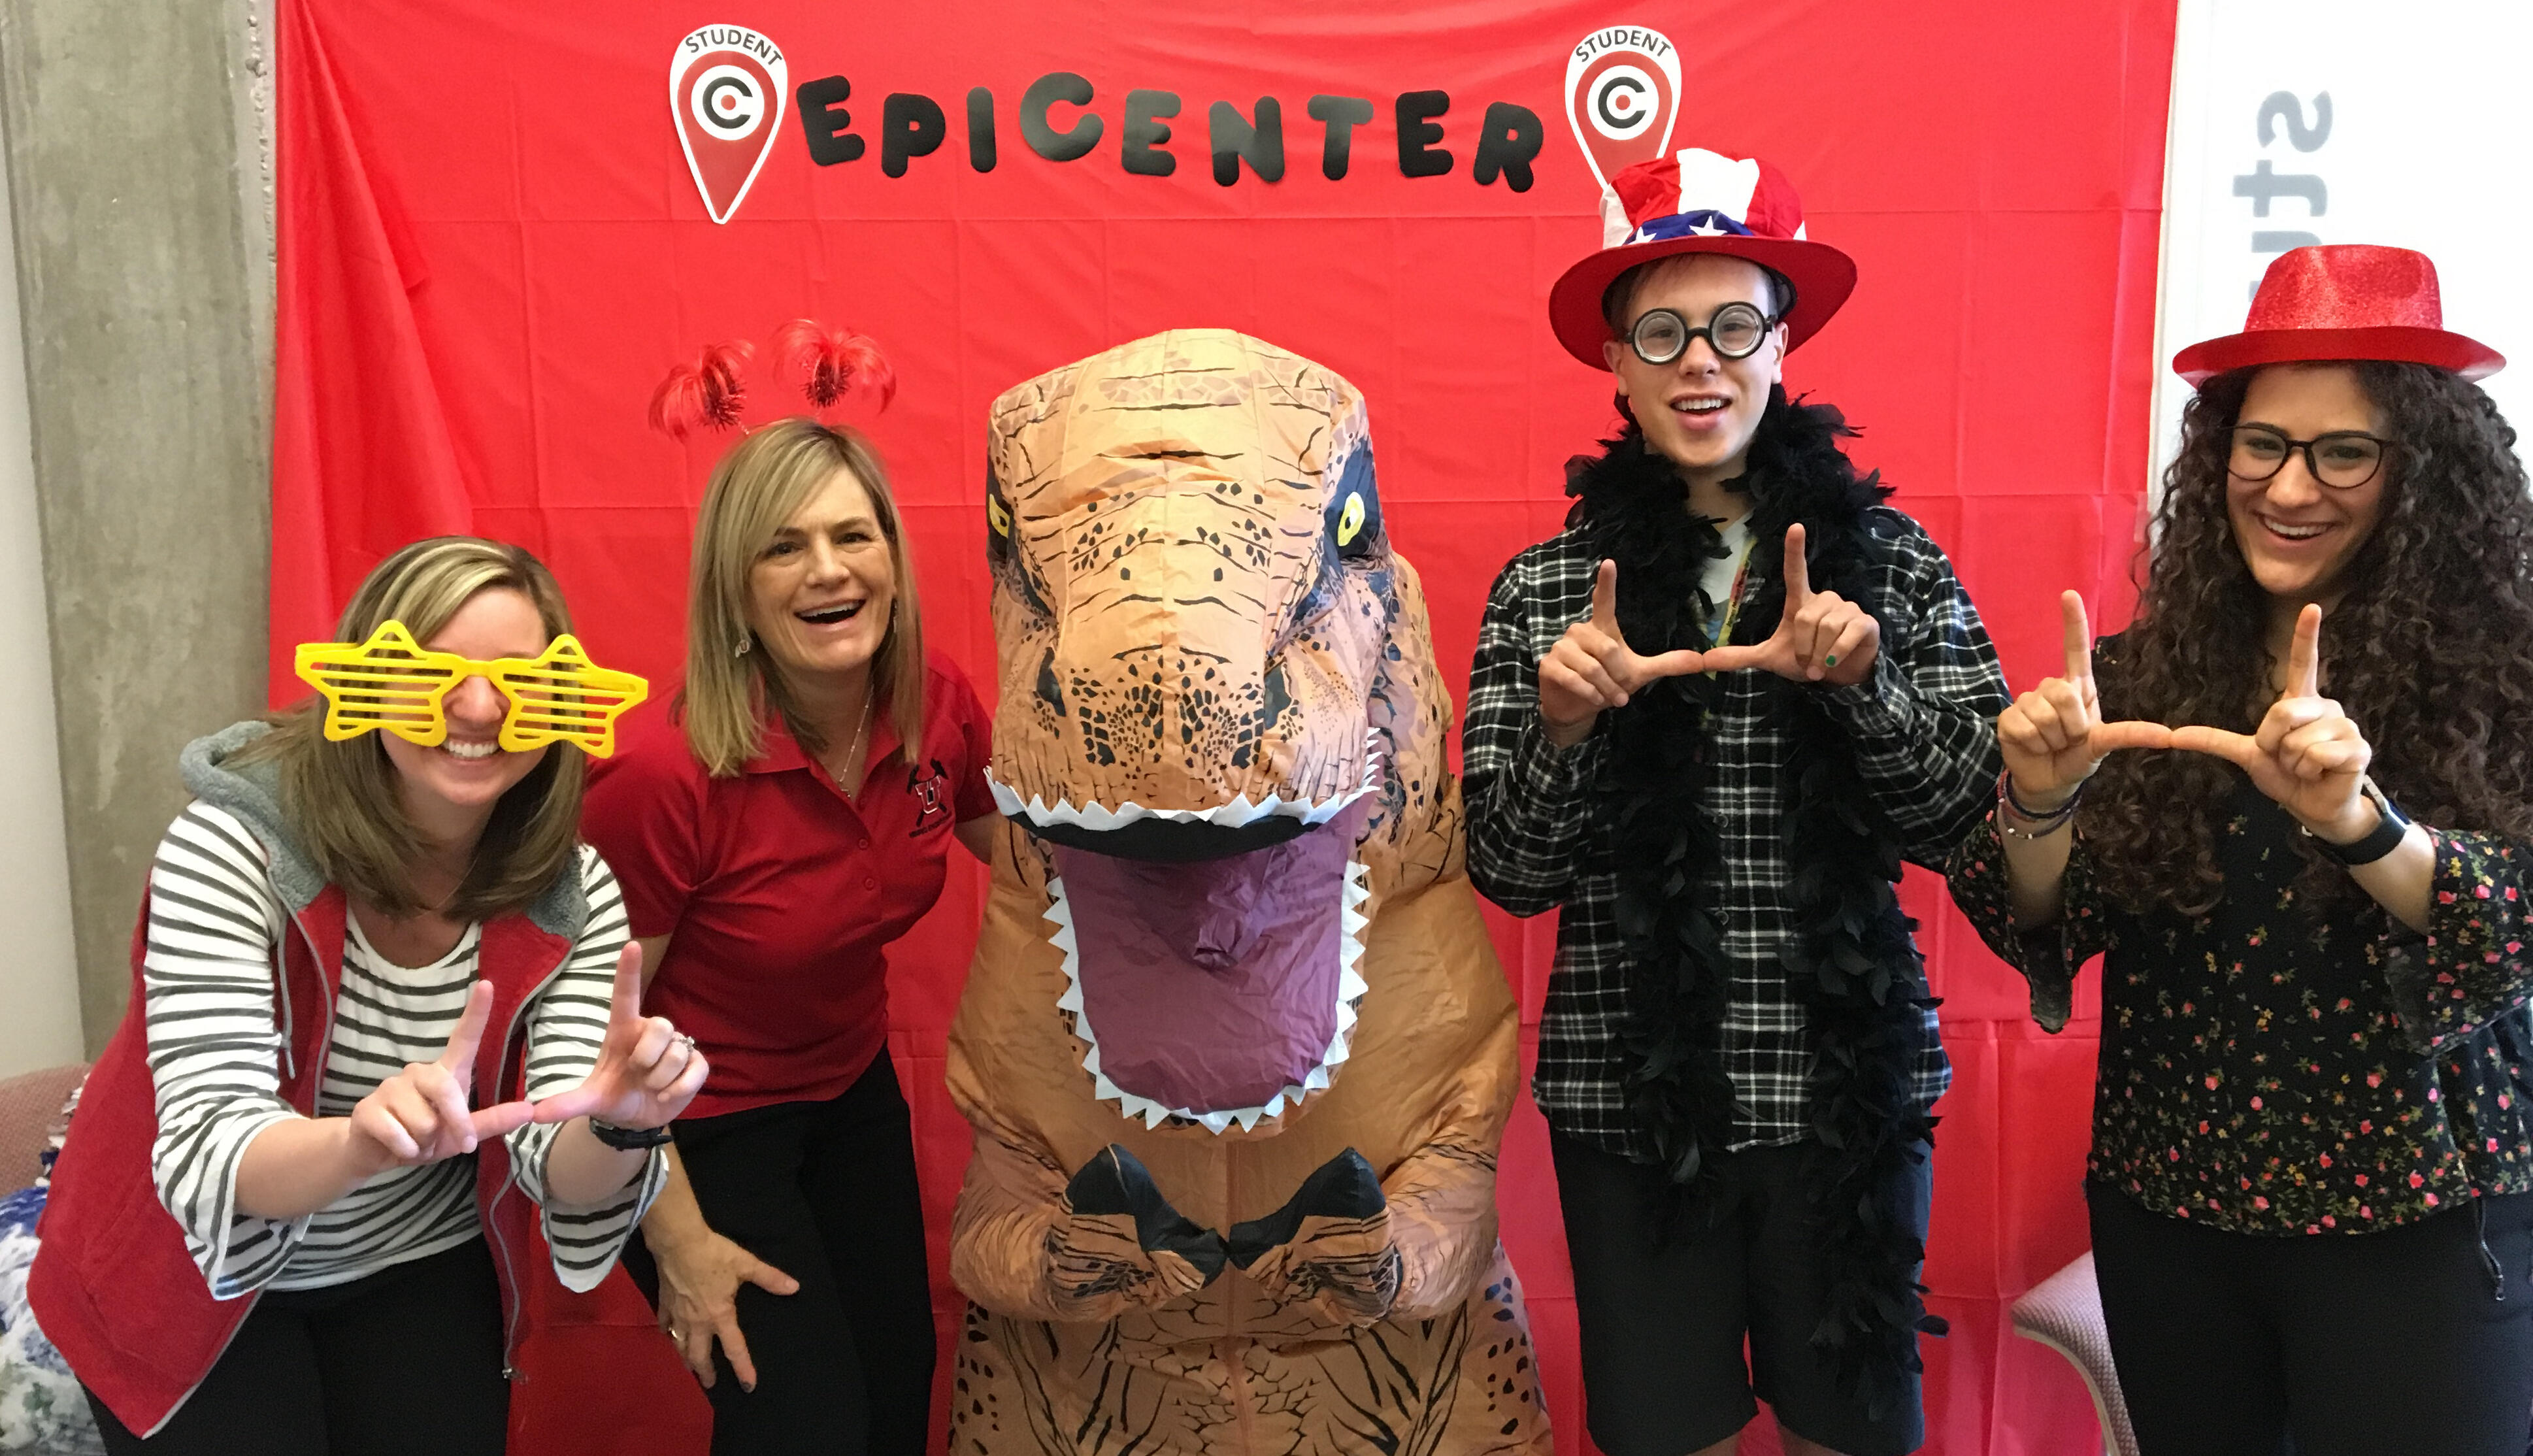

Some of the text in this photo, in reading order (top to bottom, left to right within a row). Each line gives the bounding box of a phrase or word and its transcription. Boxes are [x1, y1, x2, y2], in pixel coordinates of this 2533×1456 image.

[686, 29, 783, 65] STUDENT
[1576, 29, 1672, 62] STUDENT
[796, 72, 1544, 193] EPICENTER
